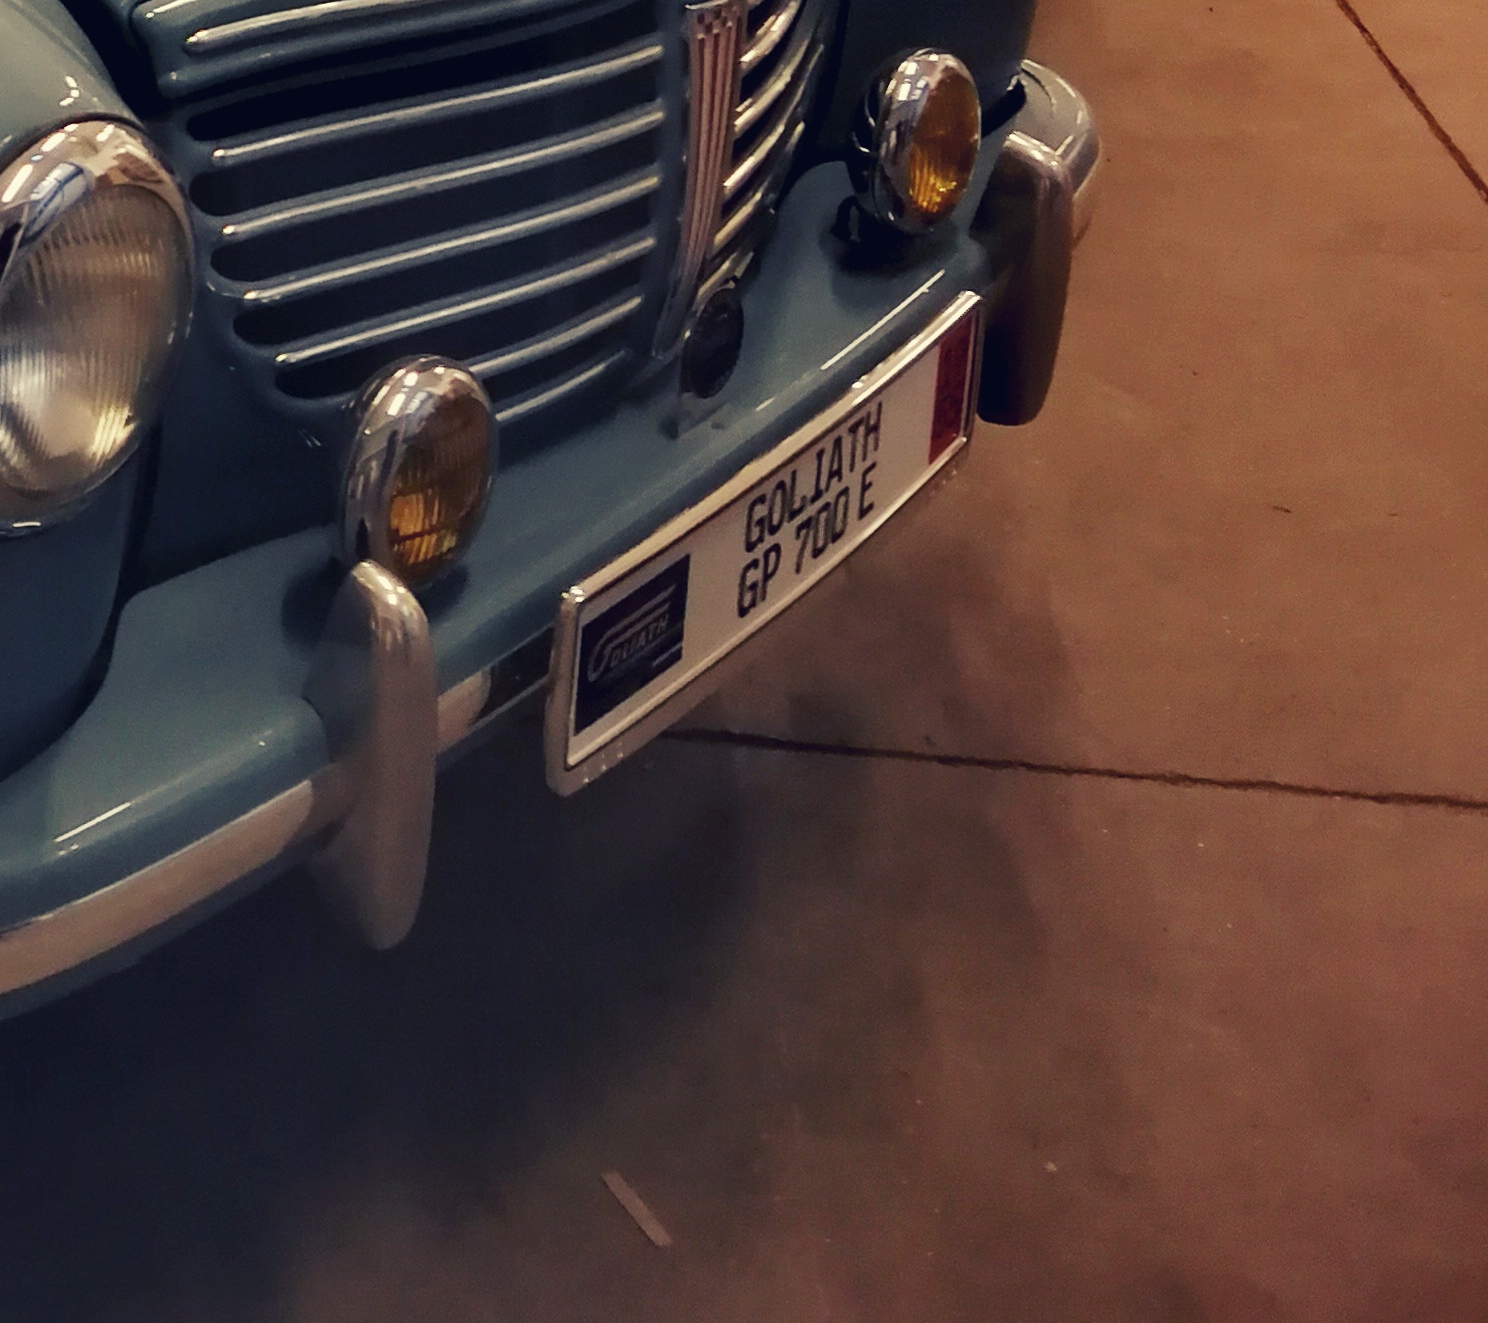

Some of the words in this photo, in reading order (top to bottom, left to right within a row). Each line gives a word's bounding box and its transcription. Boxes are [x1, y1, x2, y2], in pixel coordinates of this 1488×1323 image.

[737, 543, 782, 618] GP
[795, 486, 849, 574] 700
[857, 461, 877, 521] E
[745, 401, 883, 553] GOLIATH
